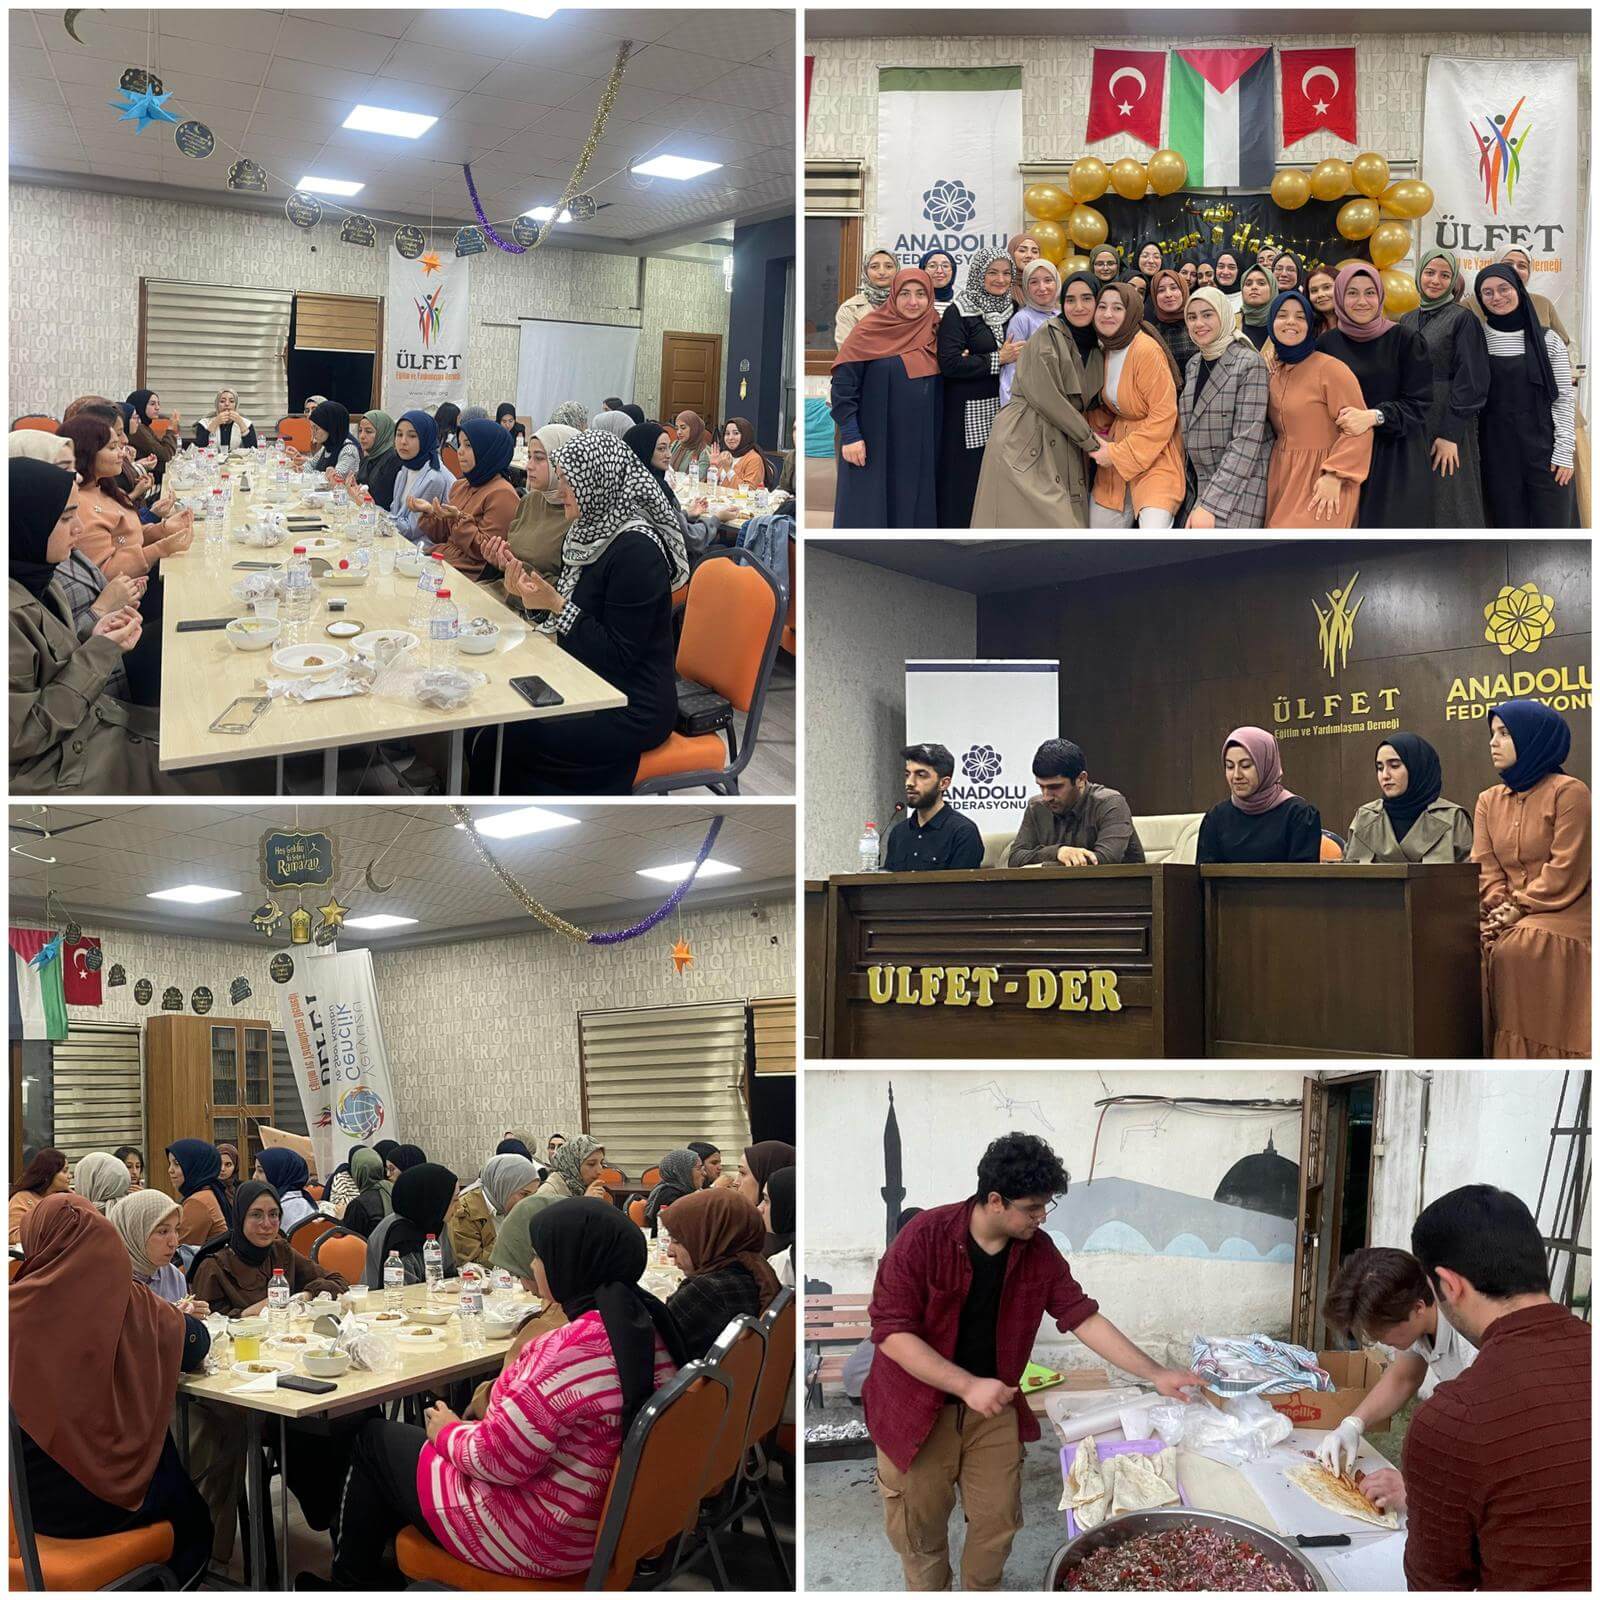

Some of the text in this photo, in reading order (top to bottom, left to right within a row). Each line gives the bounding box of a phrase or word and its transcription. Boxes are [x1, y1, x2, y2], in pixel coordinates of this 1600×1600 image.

[894, 233, 1008, 252] ANADOLU
[1435, 214, 1564, 252] ÜLFET
[396, 349, 462, 370] ÜLFET
[1273, 687, 1401, 723] ÜLFET
[1446, 693, 1592, 720] FEDEYON
[1275, 717, 1400, 740] Eğitim ve Yardımlaşma Derneği
[942, 786, 1026, 800] ANADOLU
[948, 801, 1027, 810] DERASYONU
[277, 857, 321, 877] Ramazan
